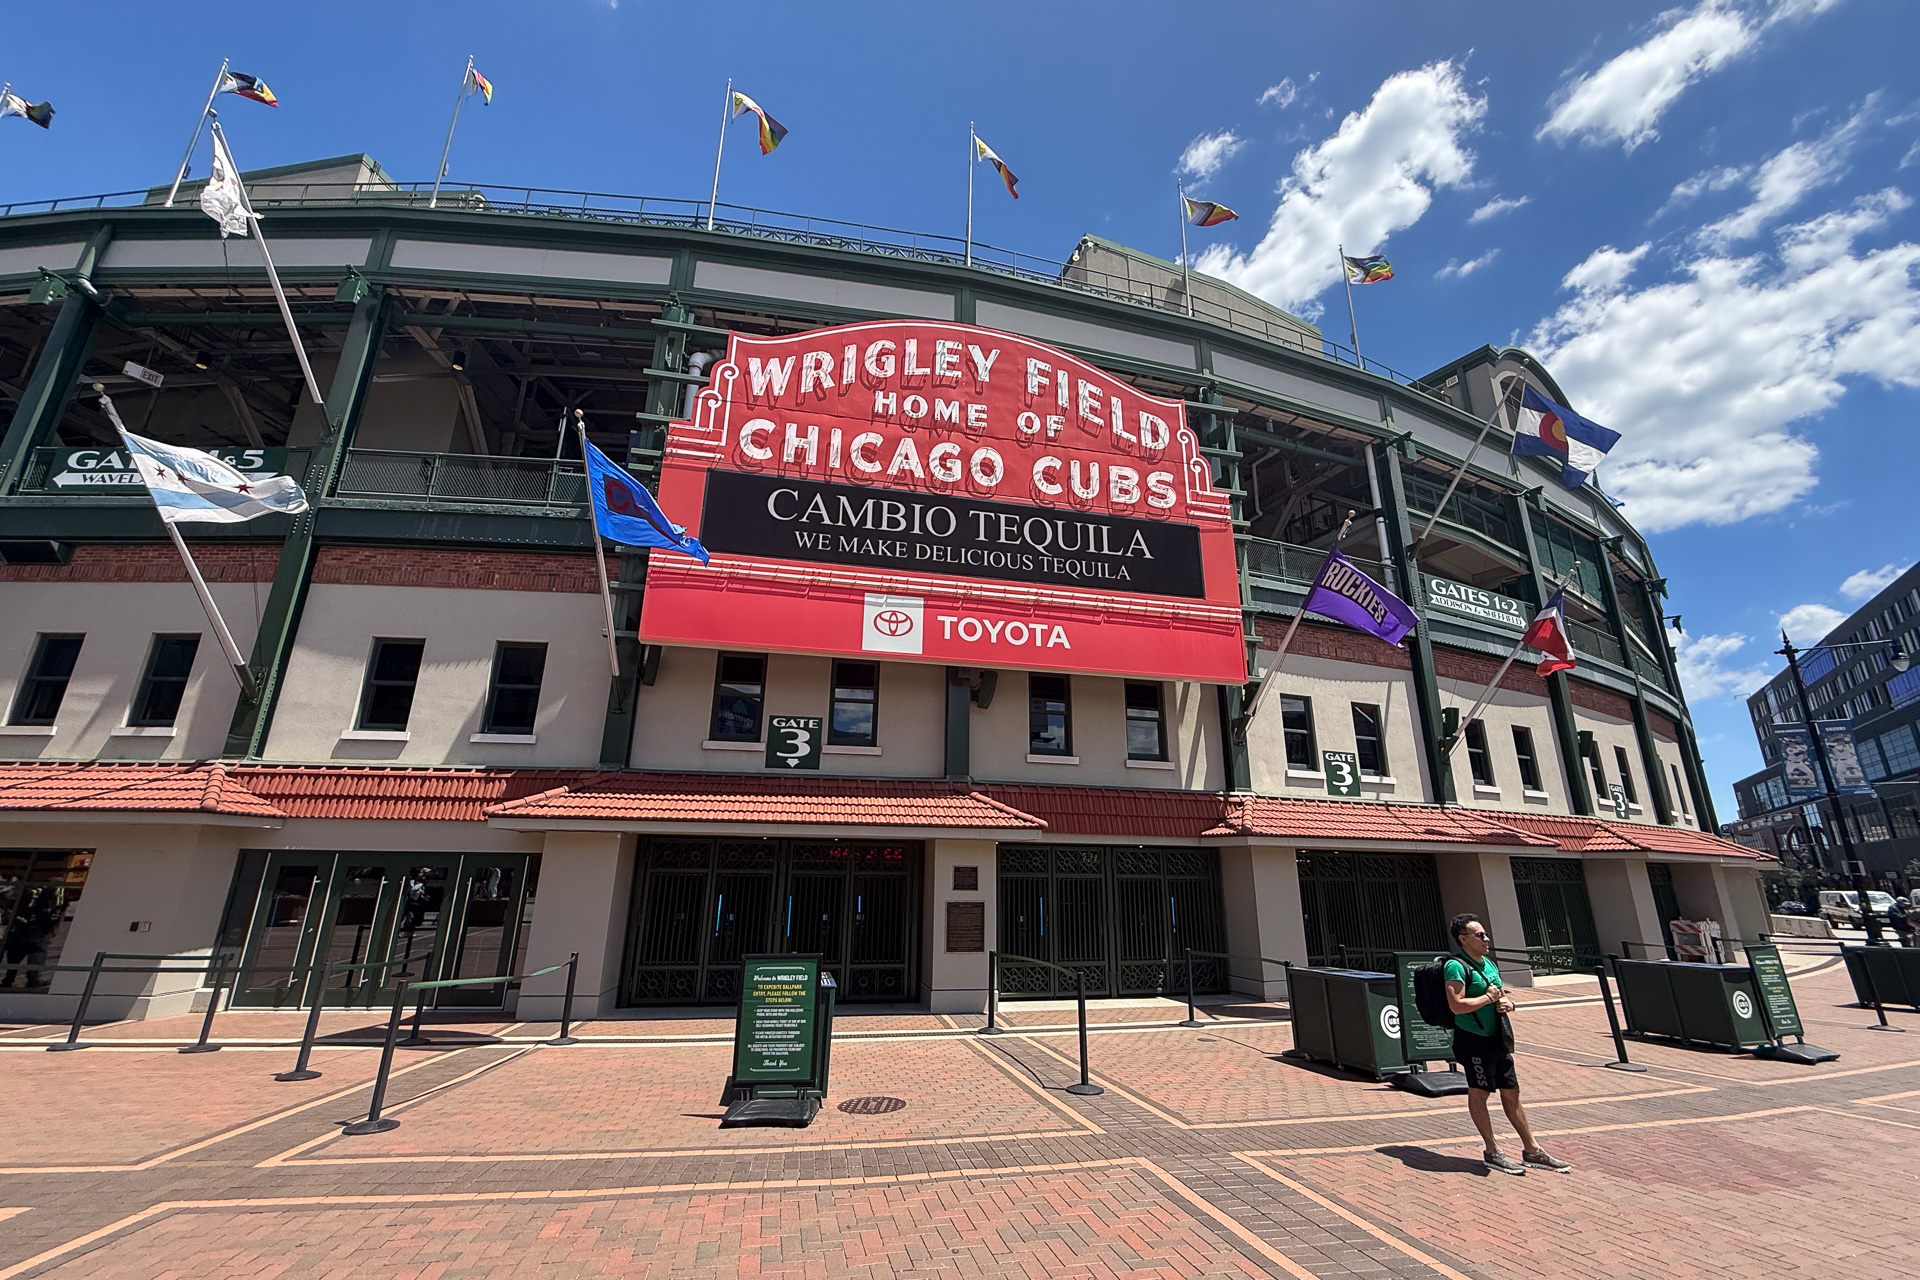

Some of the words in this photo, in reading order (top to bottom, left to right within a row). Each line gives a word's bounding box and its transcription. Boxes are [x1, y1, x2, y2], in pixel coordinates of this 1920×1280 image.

[143, 370, 159, 383] EXIT
[748, 339, 1001, 397] WRIGLEY
[1026, 357, 1170, 451] FIELD
[874, 391, 988, 428] HOME
[1017, 411, 1066, 438] OF
[739, 419, 1005, 487] CHICAGO
[1033, 456, 1177, 508] CUBS
[83, 473, 145, 484] WAVEL
[768, 489, 957, 537] CAMBIO
[969, 511, 1154, 559] TEQUILA
[794, 531, 830, 550] WE
[838, 535, 908, 558] MAKE
[916, 543, 1034, 571] DELICIOUS
[1039, 556, 1131, 581] TEQUILA
[1321, 561, 1385, 624] ROCKIES
[1431, 579, 1490, 606] GATES
[1434, 596, 1473, 612] ADDISON
[937, 615, 1072, 650] TOYOTA
[773, 718, 819, 729] GATE
[776, 728, 811, 757] 3
[1325, 752, 1355, 763] GATE
[1331, 761, 1354, 786] 3
[1613, 792, 1626, 811] 3
[1471, 1056, 1489, 1087] BOSS
